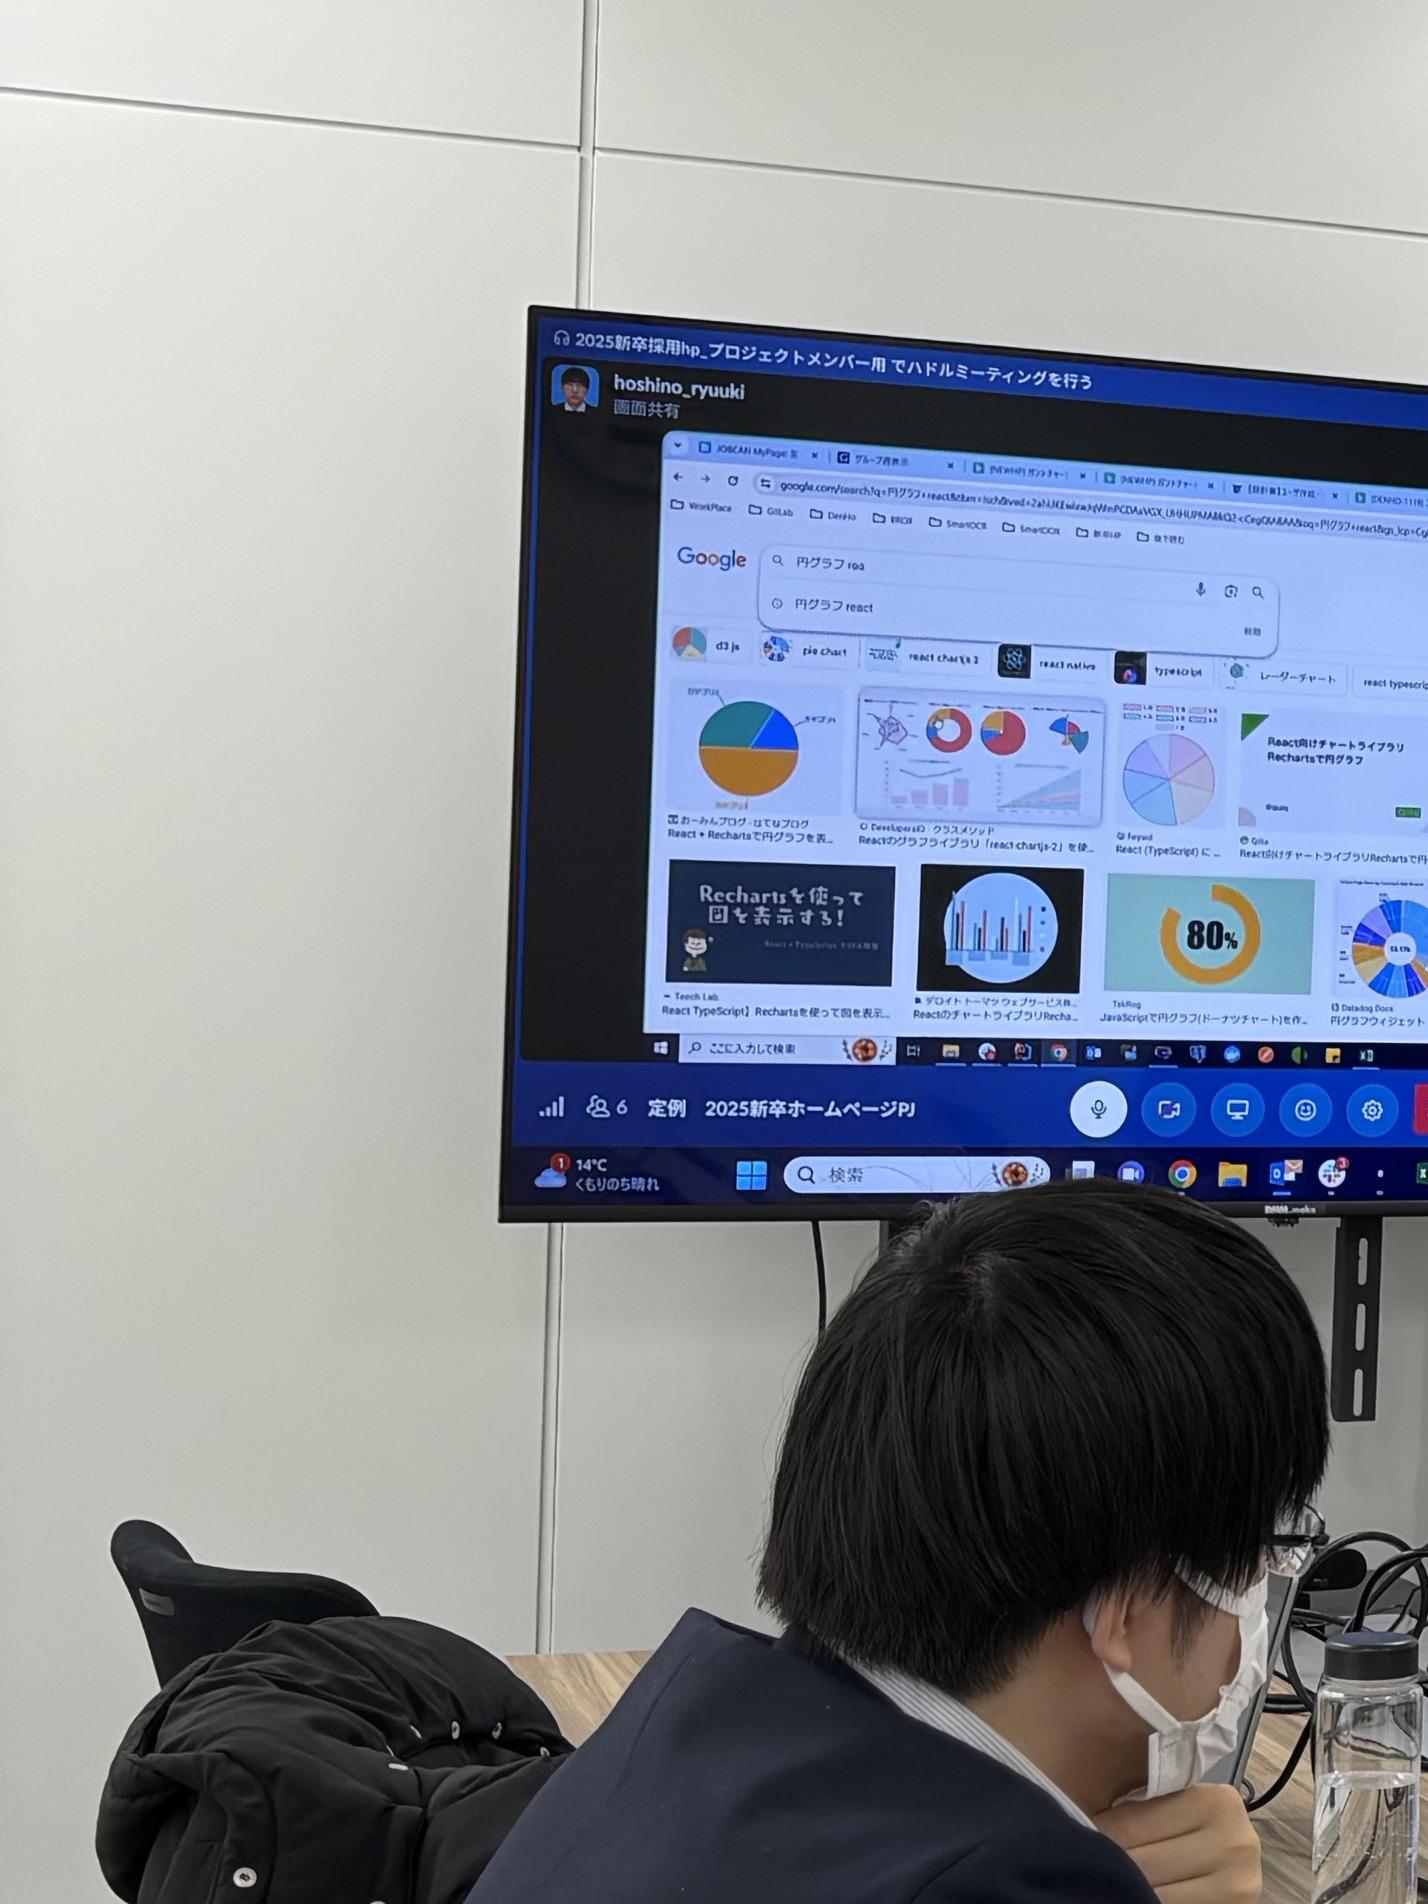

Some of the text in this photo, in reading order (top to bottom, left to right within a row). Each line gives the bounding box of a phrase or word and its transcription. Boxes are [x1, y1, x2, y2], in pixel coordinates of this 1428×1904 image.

[575, 331, 1092, 390] 2025新卒採用hp_プロジェクトメンバー用 でハドルミーティングを行う
[613, 375, 745, 401] hoshino_ryuuki
[613, 399, 680, 420] 画面共有
[677, 546, 746, 572] Google
[796, 556, 844, 571] 円グラフ
[795, 598, 873, 613] 円グラフ react
[1363, 679, 1387, 688] react
[1267, 736, 1405, 754] React向けチャートライブラリ
[1267, 752, 1364, 766] Rechartsで円グラフ
[667, 828, 696, 839] React
[699, 884, 864, 907] Rechartsを使って
[1186, 919, 1239, 951] 80%
[662, 1006, 691, 1017] React
[709, 1041, 796, 1056] ここに入力して検索
[617, 1101, 628, 1115] 6
[648, 1099, 687, 1119] 定例
[705, 1099, 916, 1120] 2025新卒ホームページPJ
[829, 1167, 864, 1184] 検索
[575, 1177, 660, 1193] くもりのち晴れ
